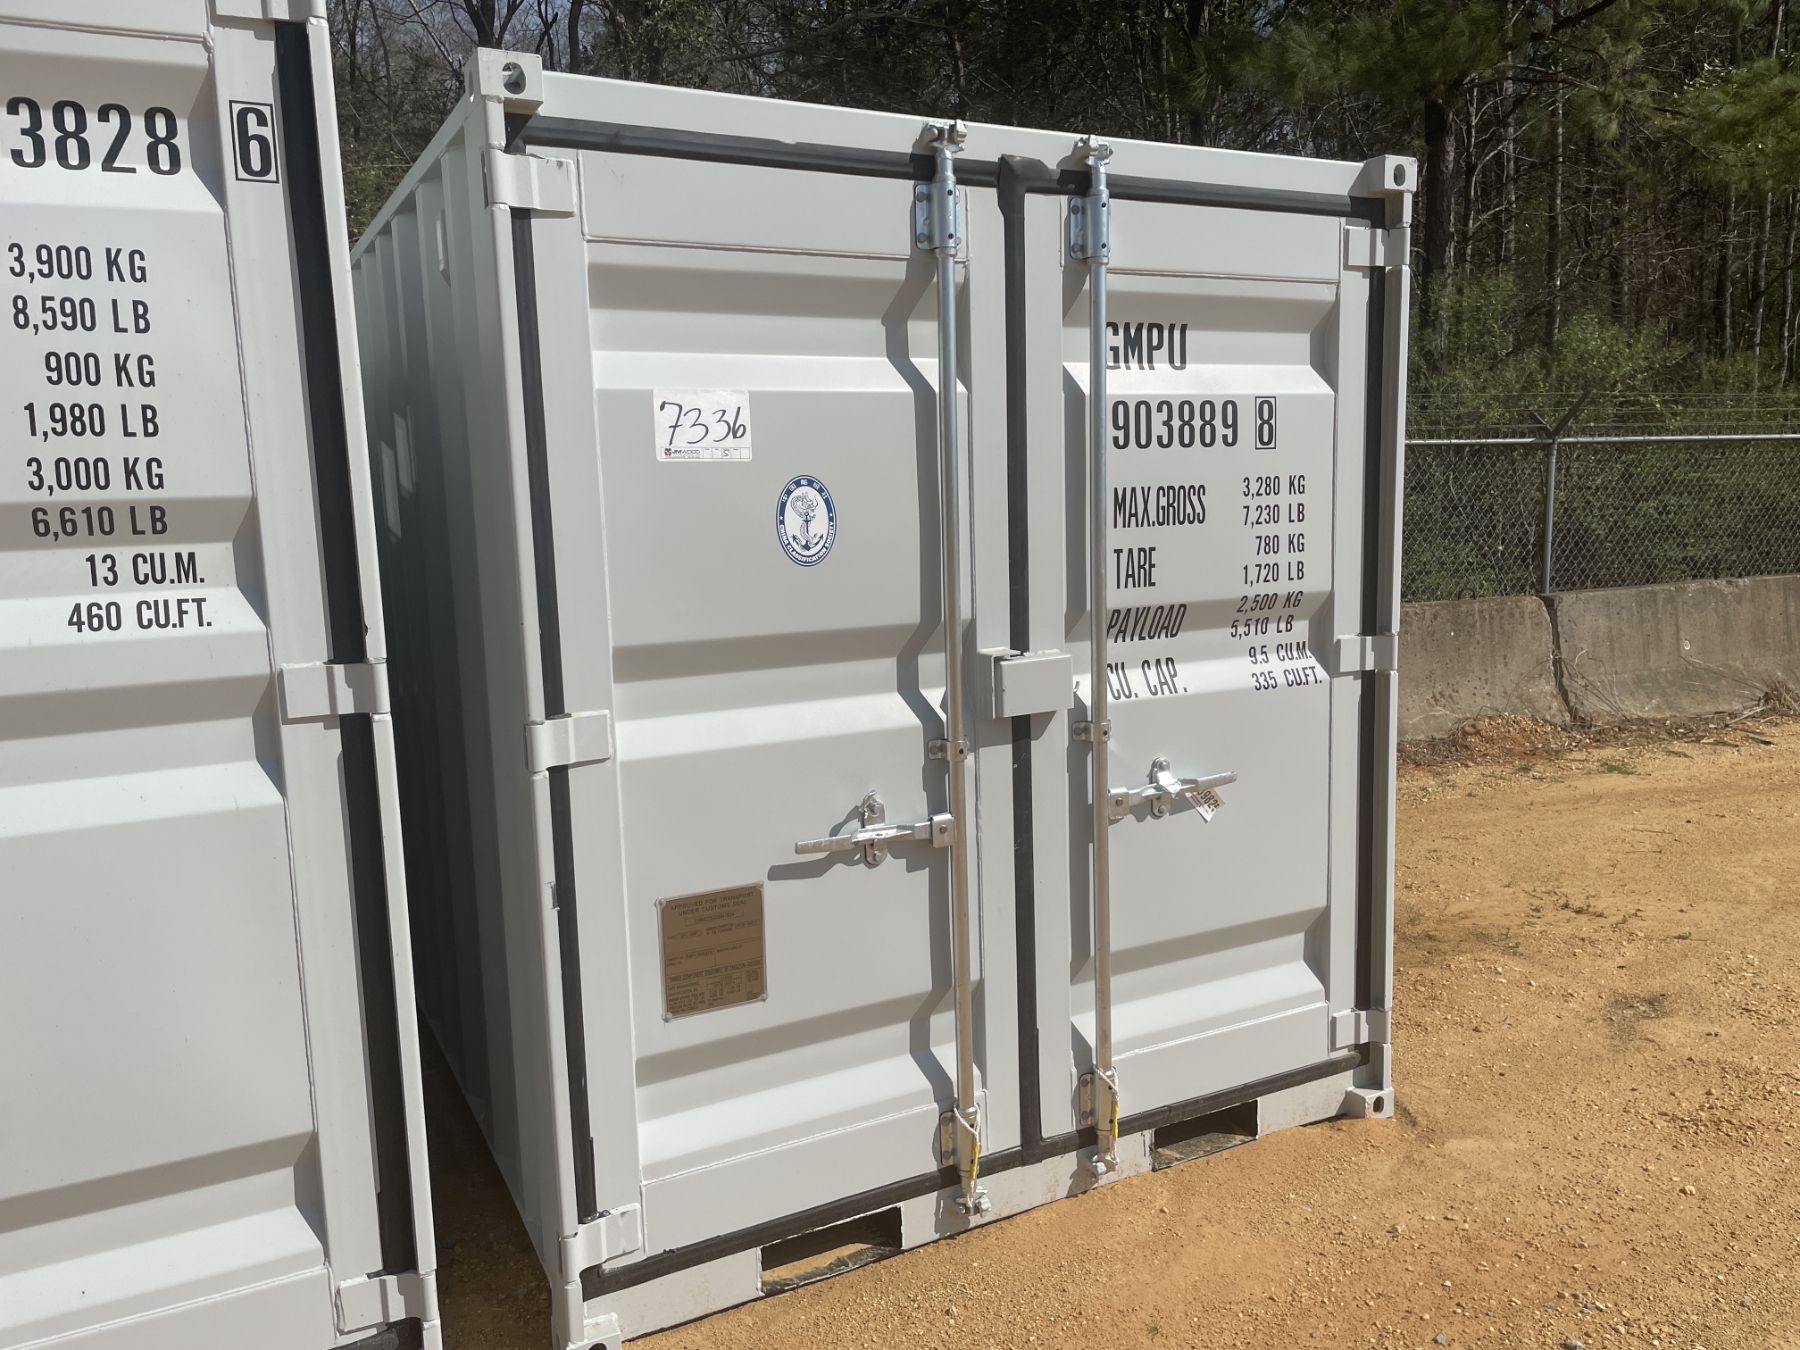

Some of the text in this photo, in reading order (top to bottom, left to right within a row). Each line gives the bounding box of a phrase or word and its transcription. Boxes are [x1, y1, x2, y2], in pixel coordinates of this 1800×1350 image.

[6, 97, 273, 178] 3828 6
[8, 243, 147, 283] 3,900 KG
[12, 295, 151, 335] 8,590 LB
[1105, 322, 1188, 371] GMPU
[45, 351, 156, 388] 900 KG
[24, 402, 160, 442] 1,980 LB
[660, 401, 747, 446] 7336
[1112, 399, 1274, 449] 903889 8
[26, 457, 164, 496] 3,000 KG
[1243, 474, 1306, 500] 3,280 KG
[31, 505, 169, 541] 6,610 LB
[1113, 485, 1206, 529] MAX.GROSS
[1243, 503, 1305, 528] 7,230 LB
[1255, 533, 1305, 556] 780 KG
[86, 552, 205, 587] 13 CU.M.
[1113, 547, 1156, 589] TARE
[1243, 561, 1305, 587] 1,720 LB
[68, 598, 212, 633] 460 CU.FT.
[1236, 590, 1304, 616] 2,500 KG
[1107, 603, 1188, 643] PAYLOAD
[1230, 614, 1294, 641] 5,510 LB
[1248, 641, 1312, 665] 9.5 CU.M.
[1107, 657, 1188, 701] CU. CAP.
[1251, 666, 1323, 691] 335 CU.FT.
